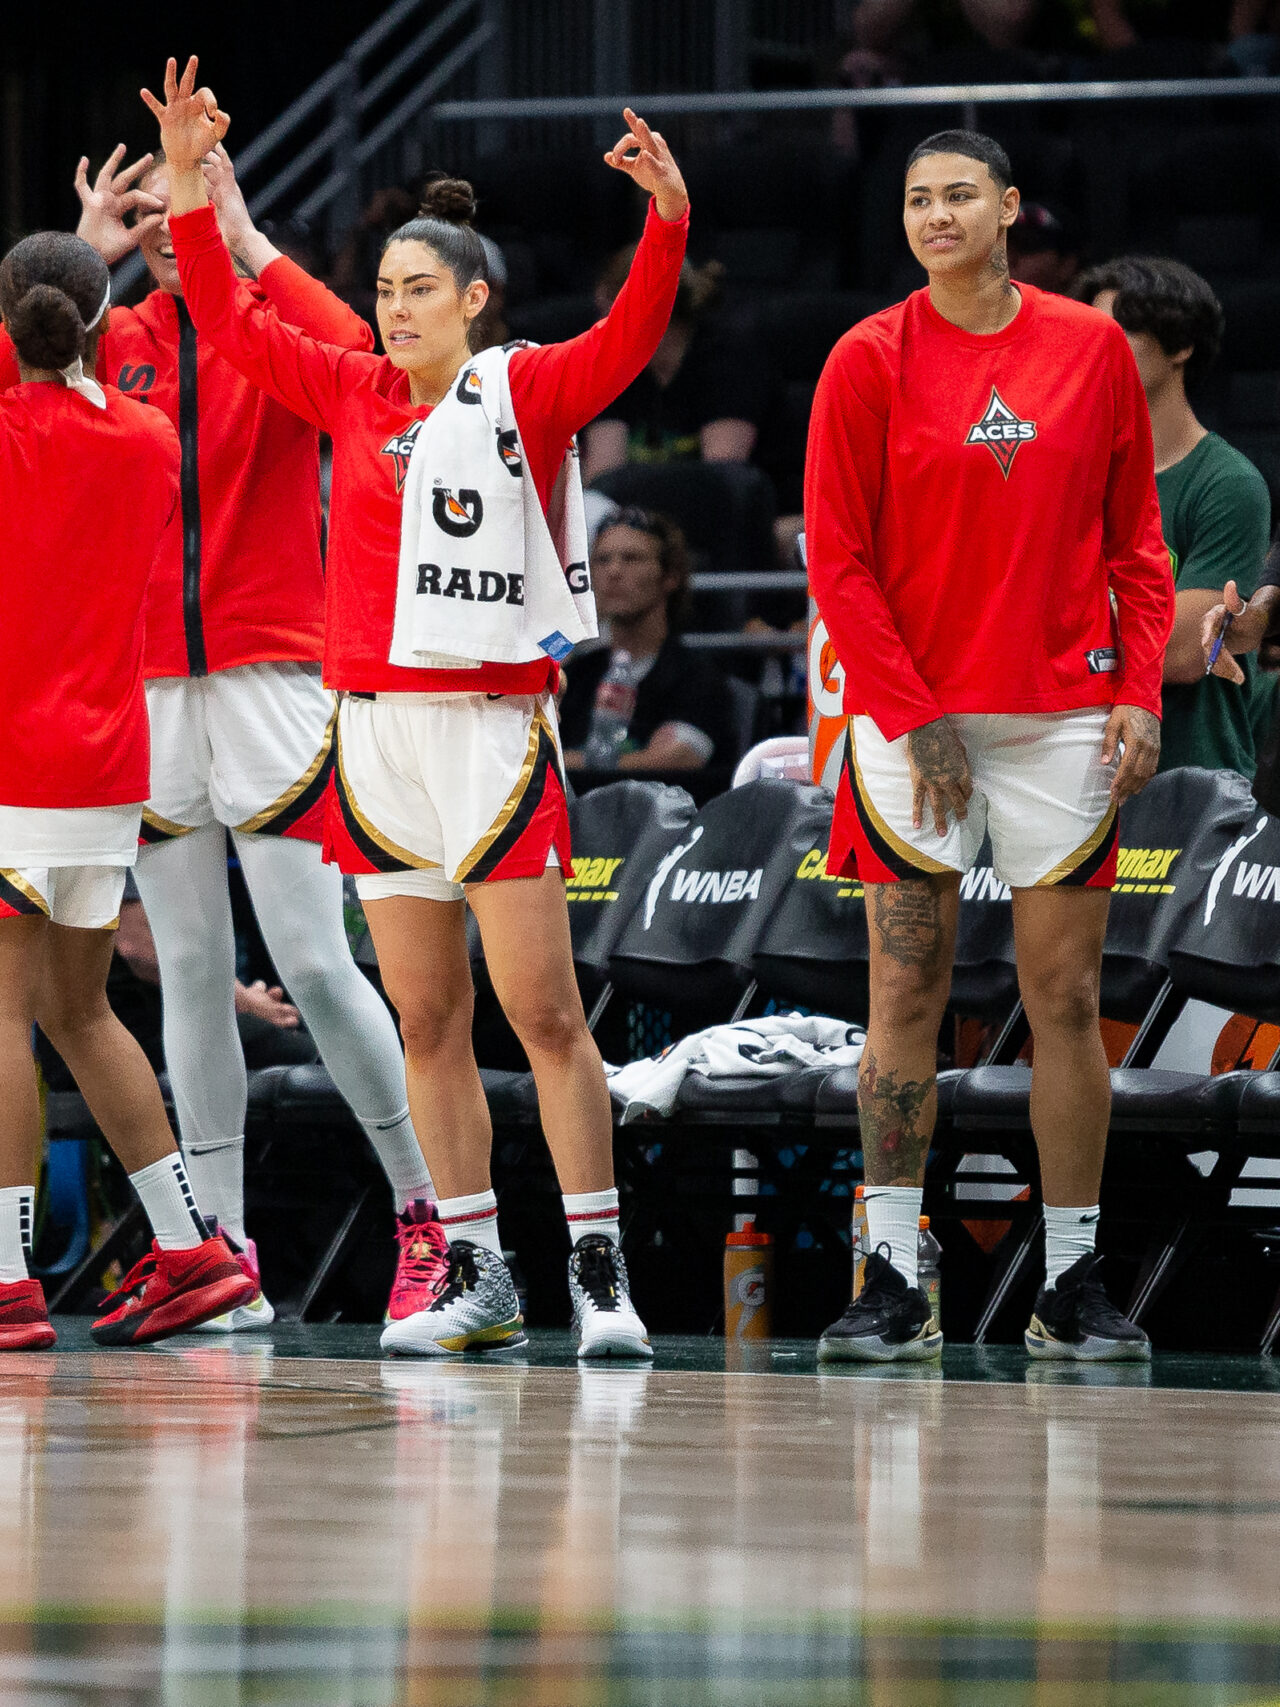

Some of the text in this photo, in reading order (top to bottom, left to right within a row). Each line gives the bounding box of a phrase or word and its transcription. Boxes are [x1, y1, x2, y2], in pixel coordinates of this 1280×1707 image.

[970, 423, 1035, 441] ACES
[384, 438, 416, 455] AC
[670, 868, 764, 903] WNBA
[1232, 860, 1280, 902] WN
